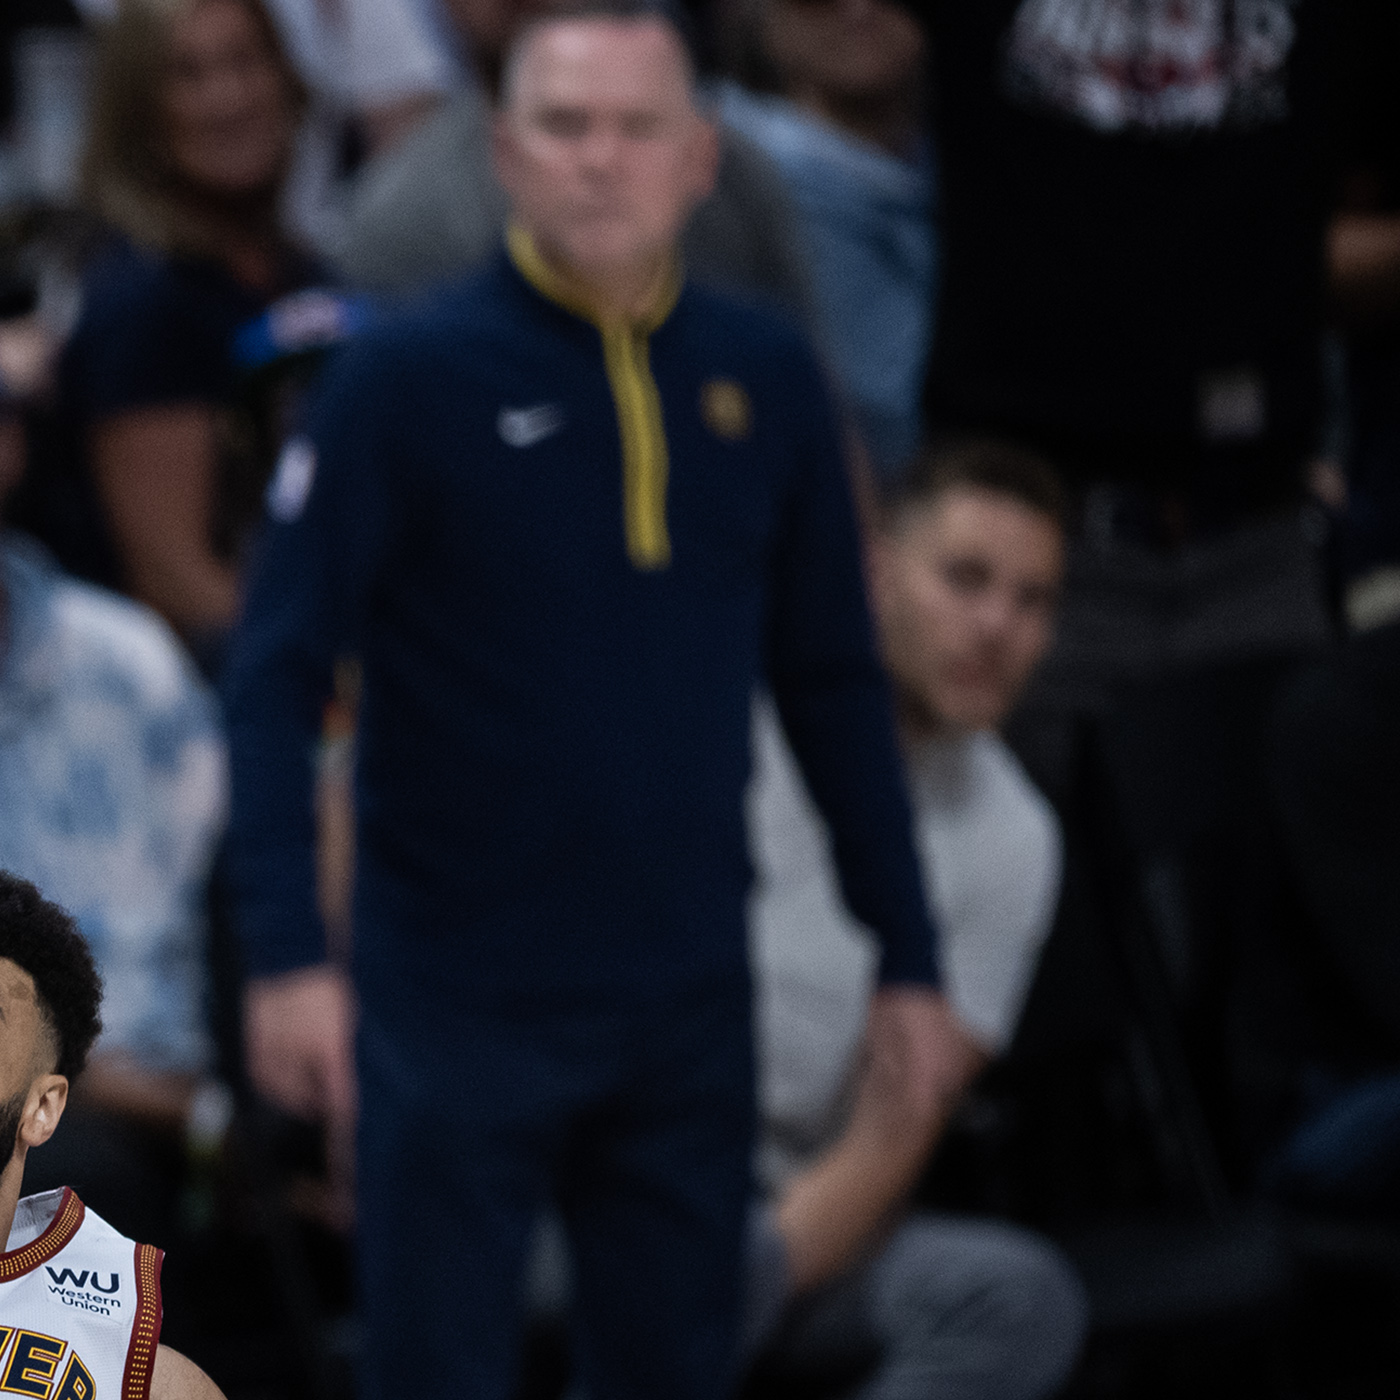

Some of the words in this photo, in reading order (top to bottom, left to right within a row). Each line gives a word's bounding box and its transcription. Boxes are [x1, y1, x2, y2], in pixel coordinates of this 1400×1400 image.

[44, 1265, 120, 1294] WU
[47, 1284, 121, 1308] Western
[61, 1297, 111, 1316] Union
